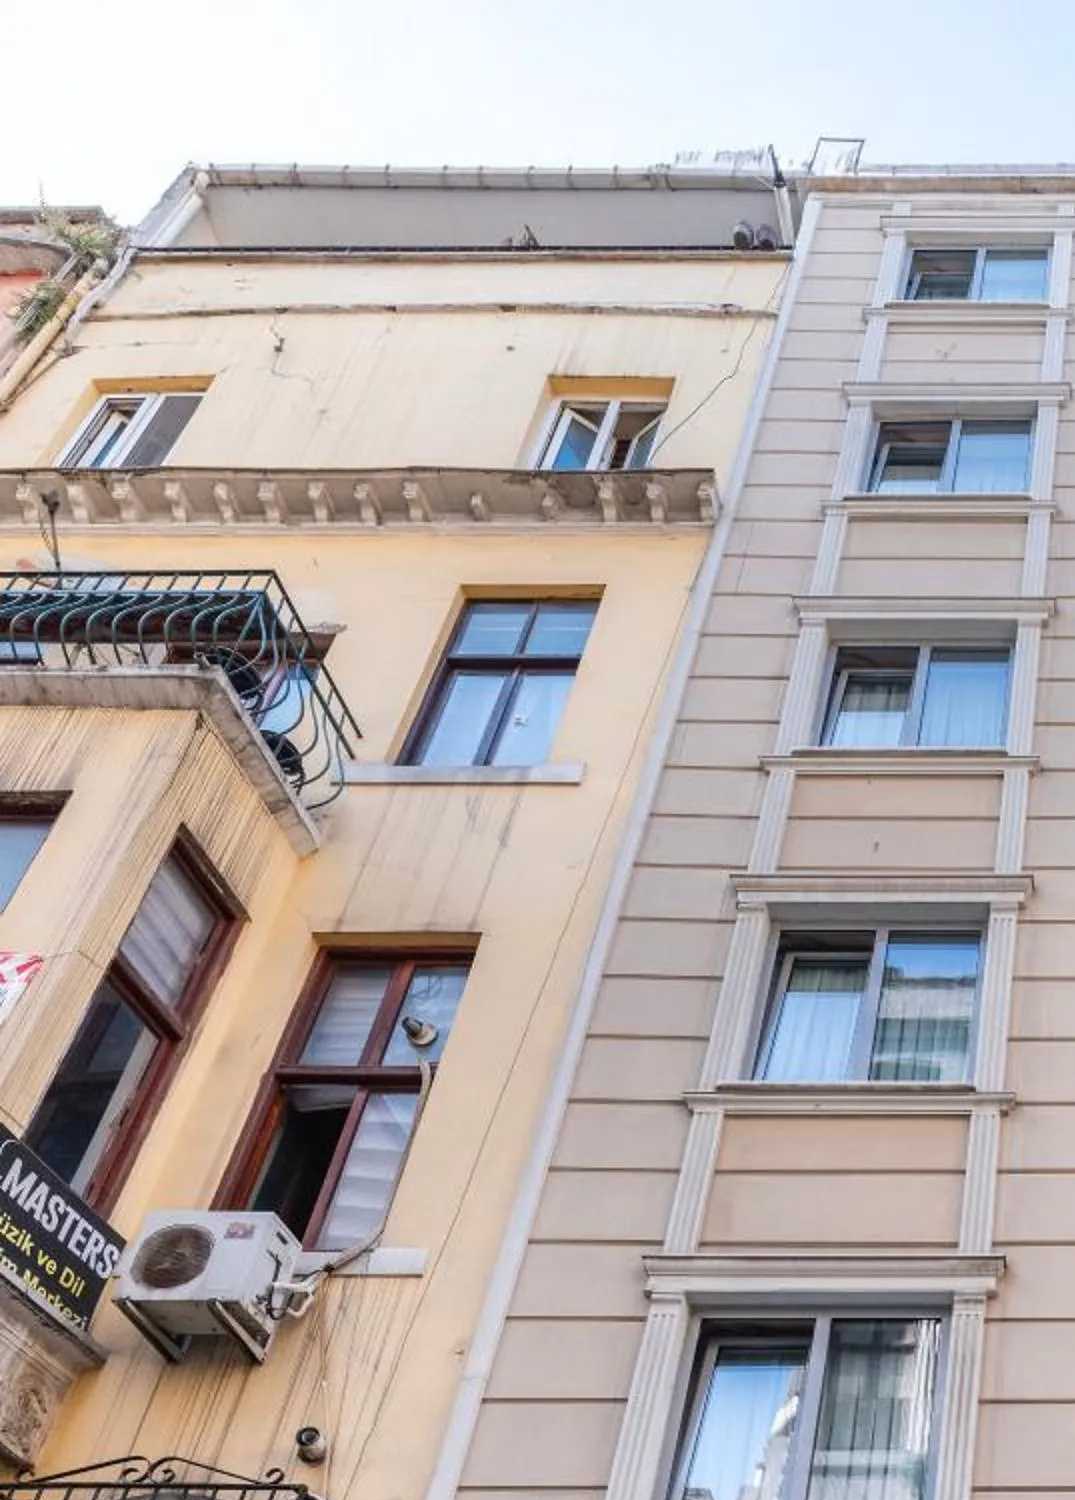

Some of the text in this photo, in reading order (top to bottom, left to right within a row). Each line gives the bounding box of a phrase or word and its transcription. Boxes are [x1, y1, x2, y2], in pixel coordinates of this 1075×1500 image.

[1, 1157, 120, 1280] MASTERS
[37, 1249, 57, 1274] ve
[59, 1266, 86, 1297] Dil
